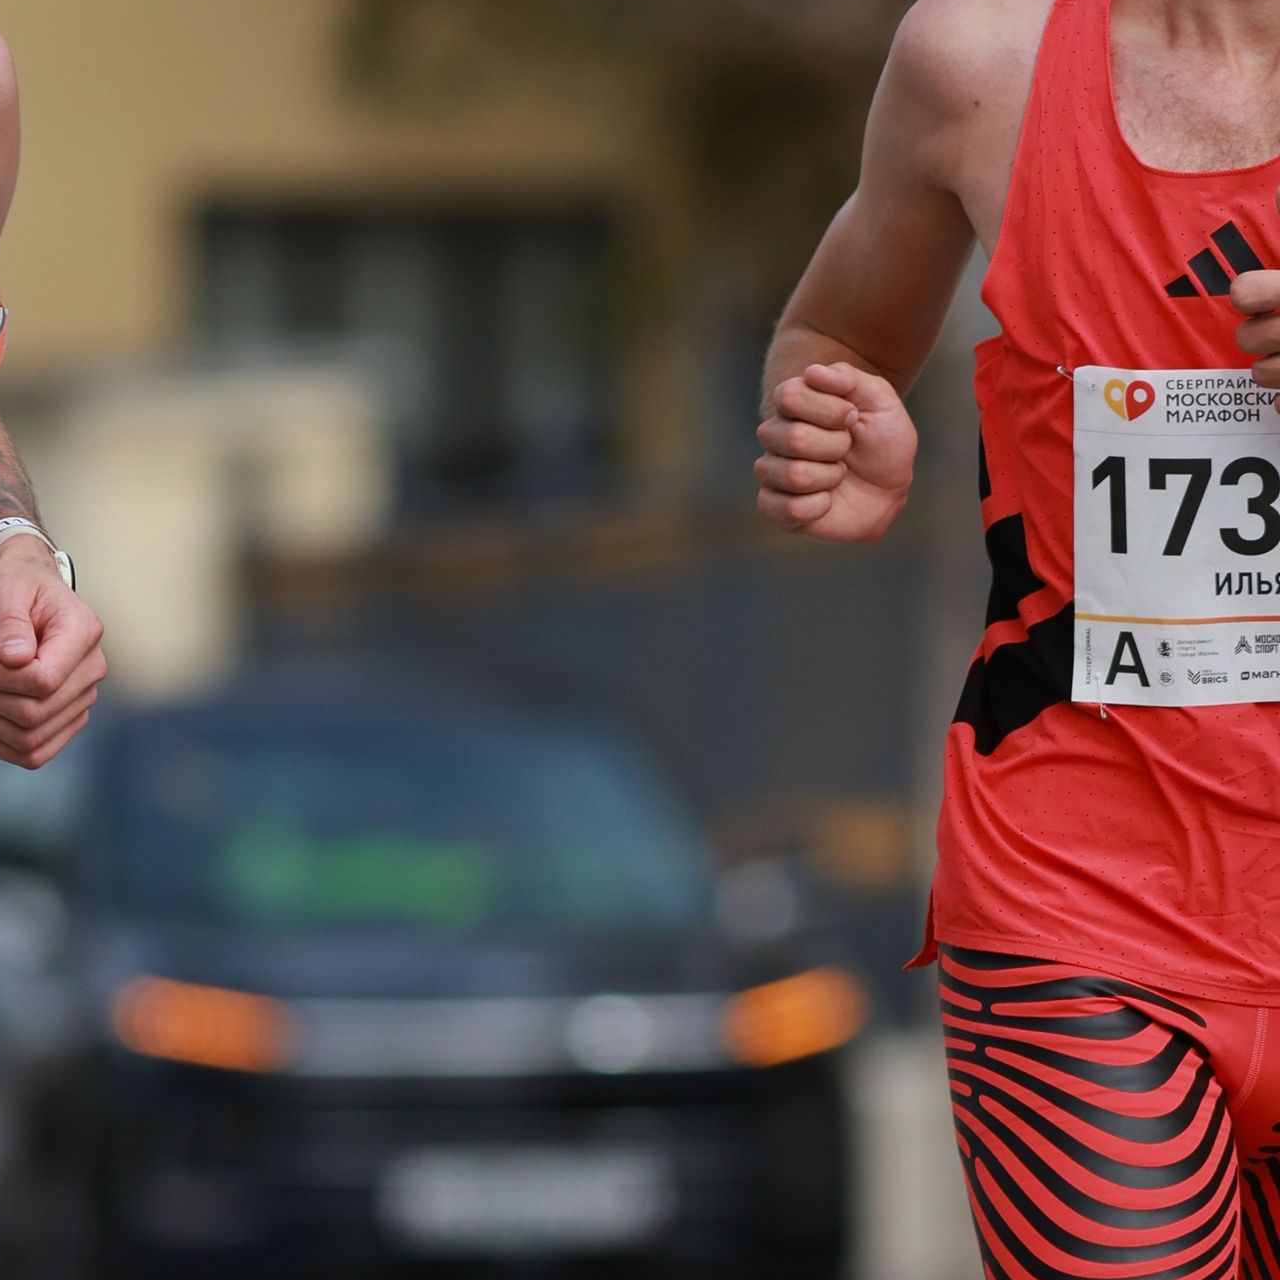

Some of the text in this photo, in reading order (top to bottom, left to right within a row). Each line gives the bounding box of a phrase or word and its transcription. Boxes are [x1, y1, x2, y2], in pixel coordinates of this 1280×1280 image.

[1166, 408, 1260, 423] МАРАФОН
[1092, 456, 1280, 556] 173
[1255, 644, 1278, 654] СПОРТ
[1201, 676, 1228, 685] BRICS
